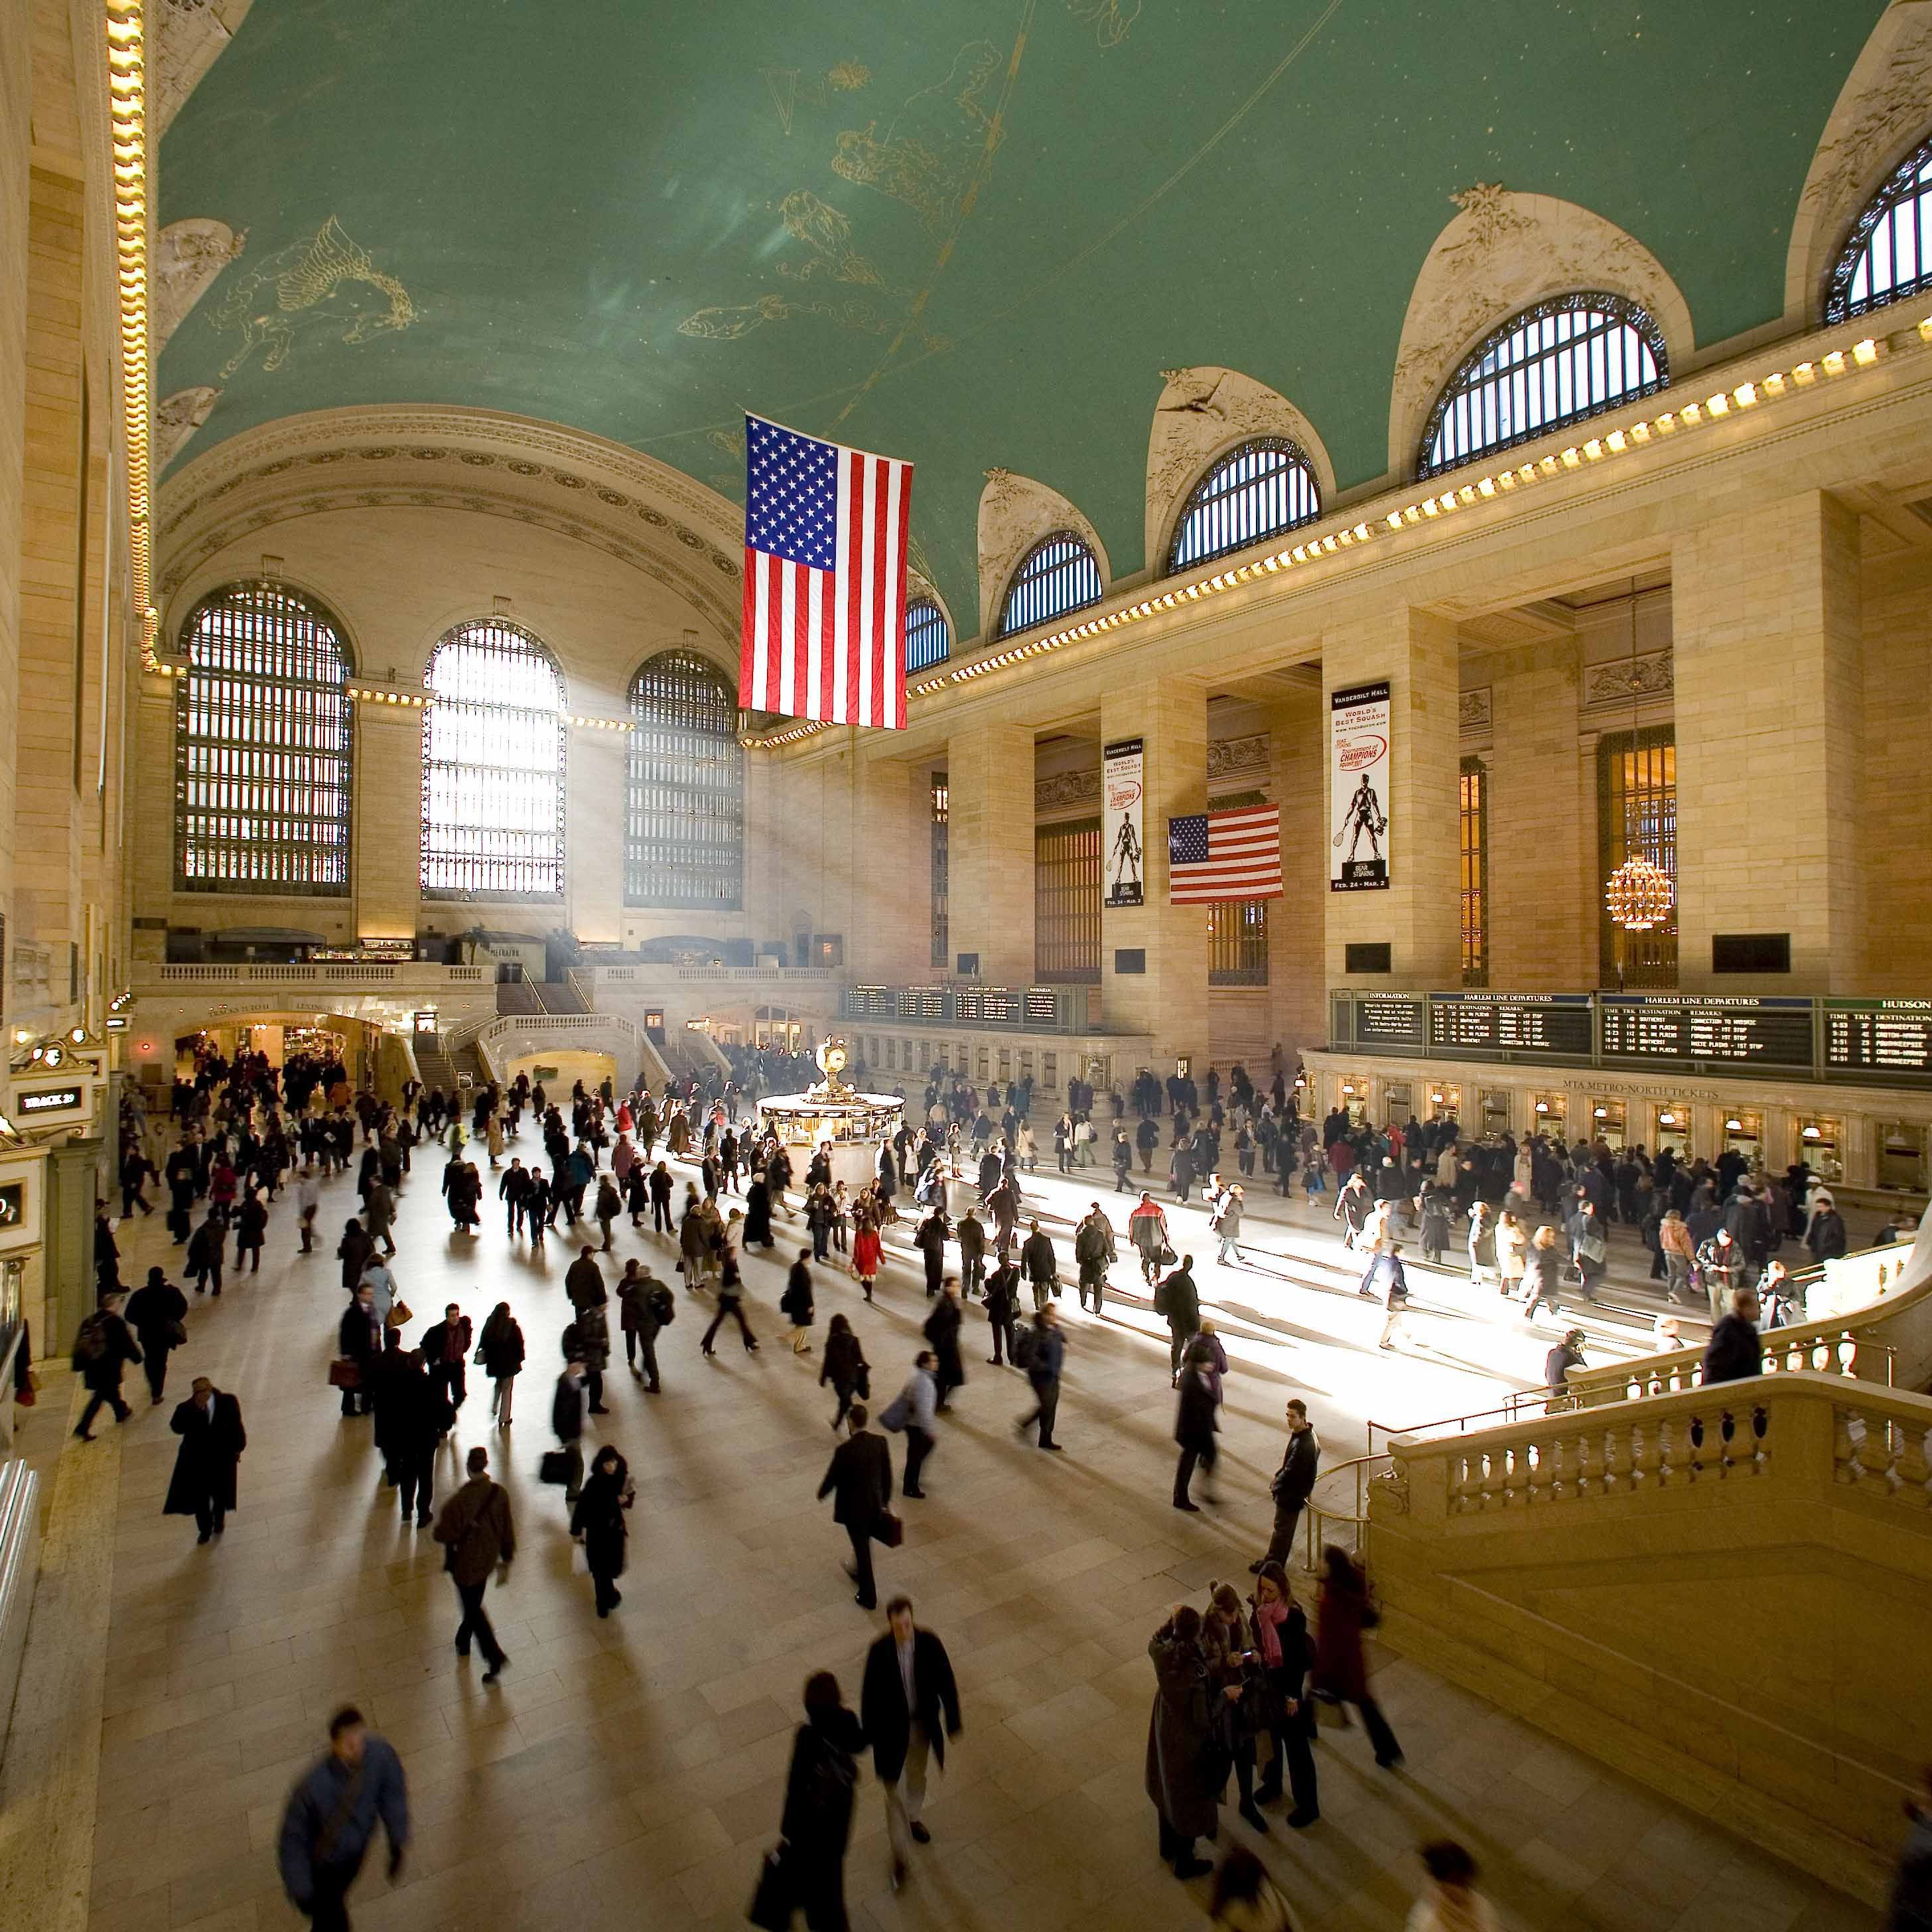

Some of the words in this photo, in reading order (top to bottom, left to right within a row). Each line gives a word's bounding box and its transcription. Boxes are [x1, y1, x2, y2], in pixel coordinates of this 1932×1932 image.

[1334, 693, 1369, 703] VANDERBILT
[1346, 707, 1376, 717] WORLD'S
[1356, 713, 1385, 723] SQUASH
[1340, 749, 1377, 762] CHAMPIONS
[1704, 997, 1760, 1006] DEPARTURES
[1882, 1000, 1932, 1009] HUDSON
[1563, 1080, 1584, 1089] MTA
[1587, 1080, 1668, 1096] METRO-NORTH
[1671, 1087, 1718, 1099] TICKETS
[23, 1095, 63, 1109] TRACK
